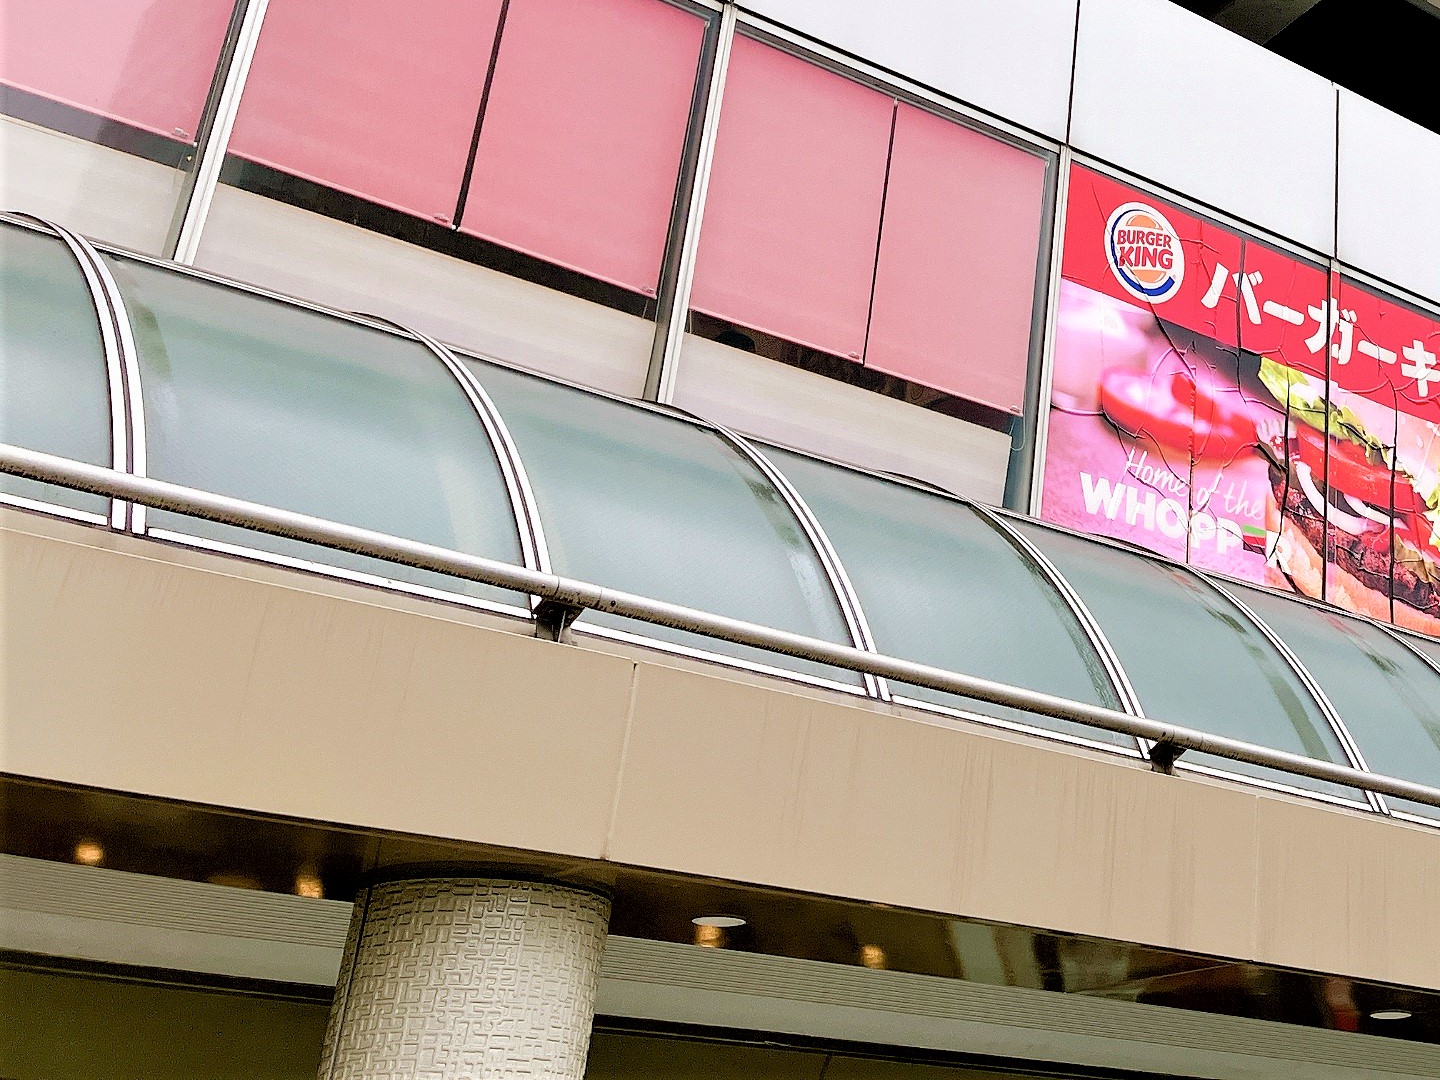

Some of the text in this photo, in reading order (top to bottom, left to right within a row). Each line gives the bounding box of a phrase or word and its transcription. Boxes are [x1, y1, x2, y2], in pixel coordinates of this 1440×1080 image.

[1117, 229, 1172, 249] BURGER
[1118, 245, 1174, 270] KING
[1122, 447, 1264, 520] Home of the
